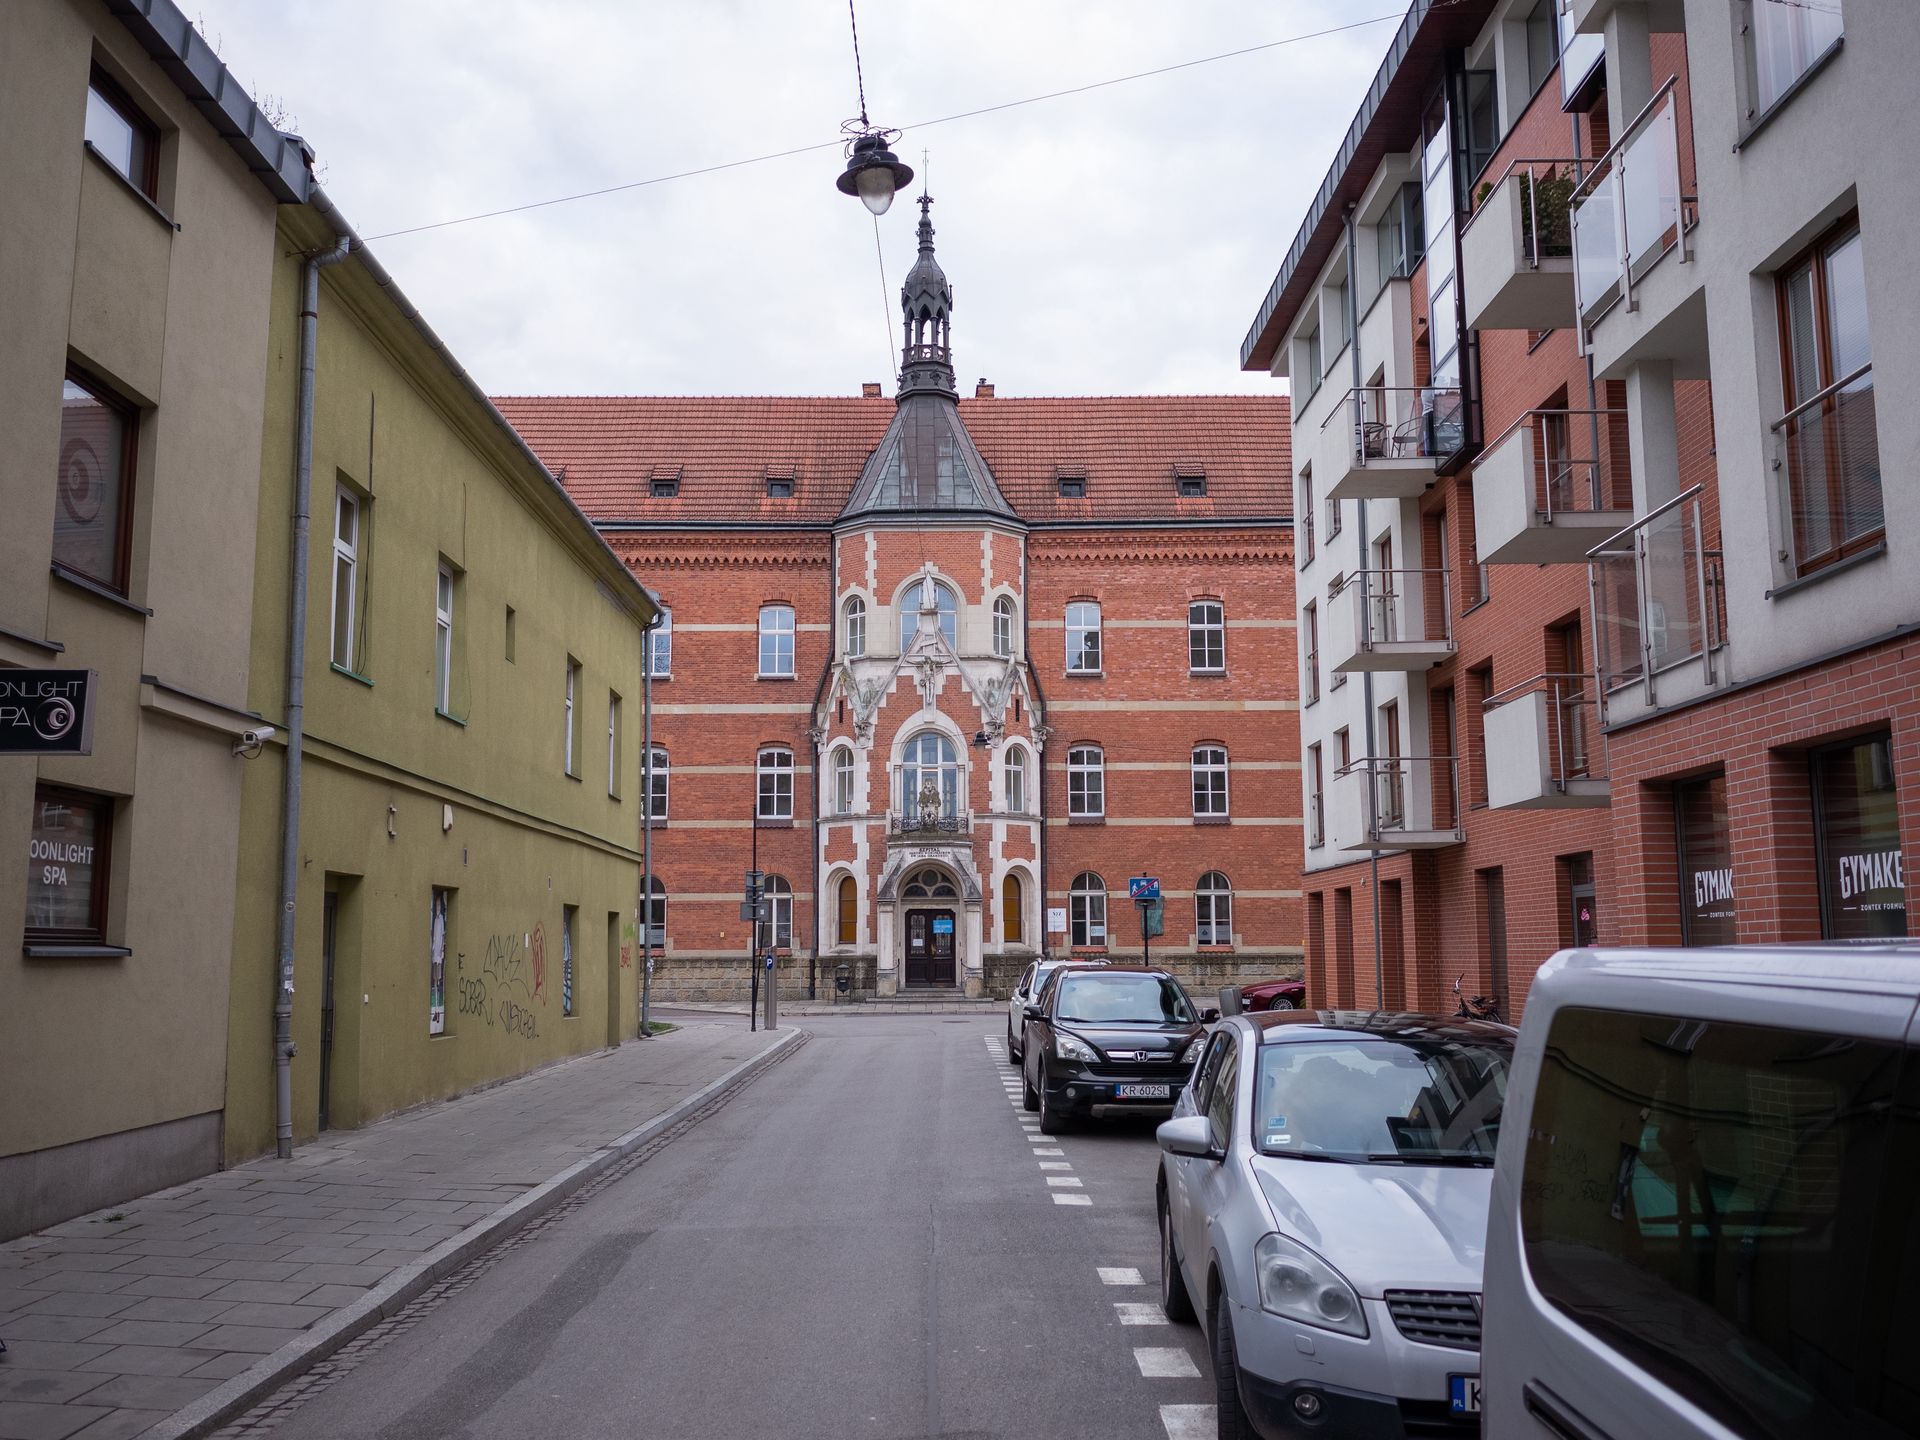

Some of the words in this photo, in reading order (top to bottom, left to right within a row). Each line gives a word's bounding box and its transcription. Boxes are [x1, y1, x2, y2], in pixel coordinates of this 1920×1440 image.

[30, 839, 94, 864] OONLIGHT
[43, 865, 67, 886] SPA
[1122, 1085, 1137, 1096] KR
[1139, 1085, 1169, 1096] 602SL
[1453, 1399, 1463, 1408] PL
